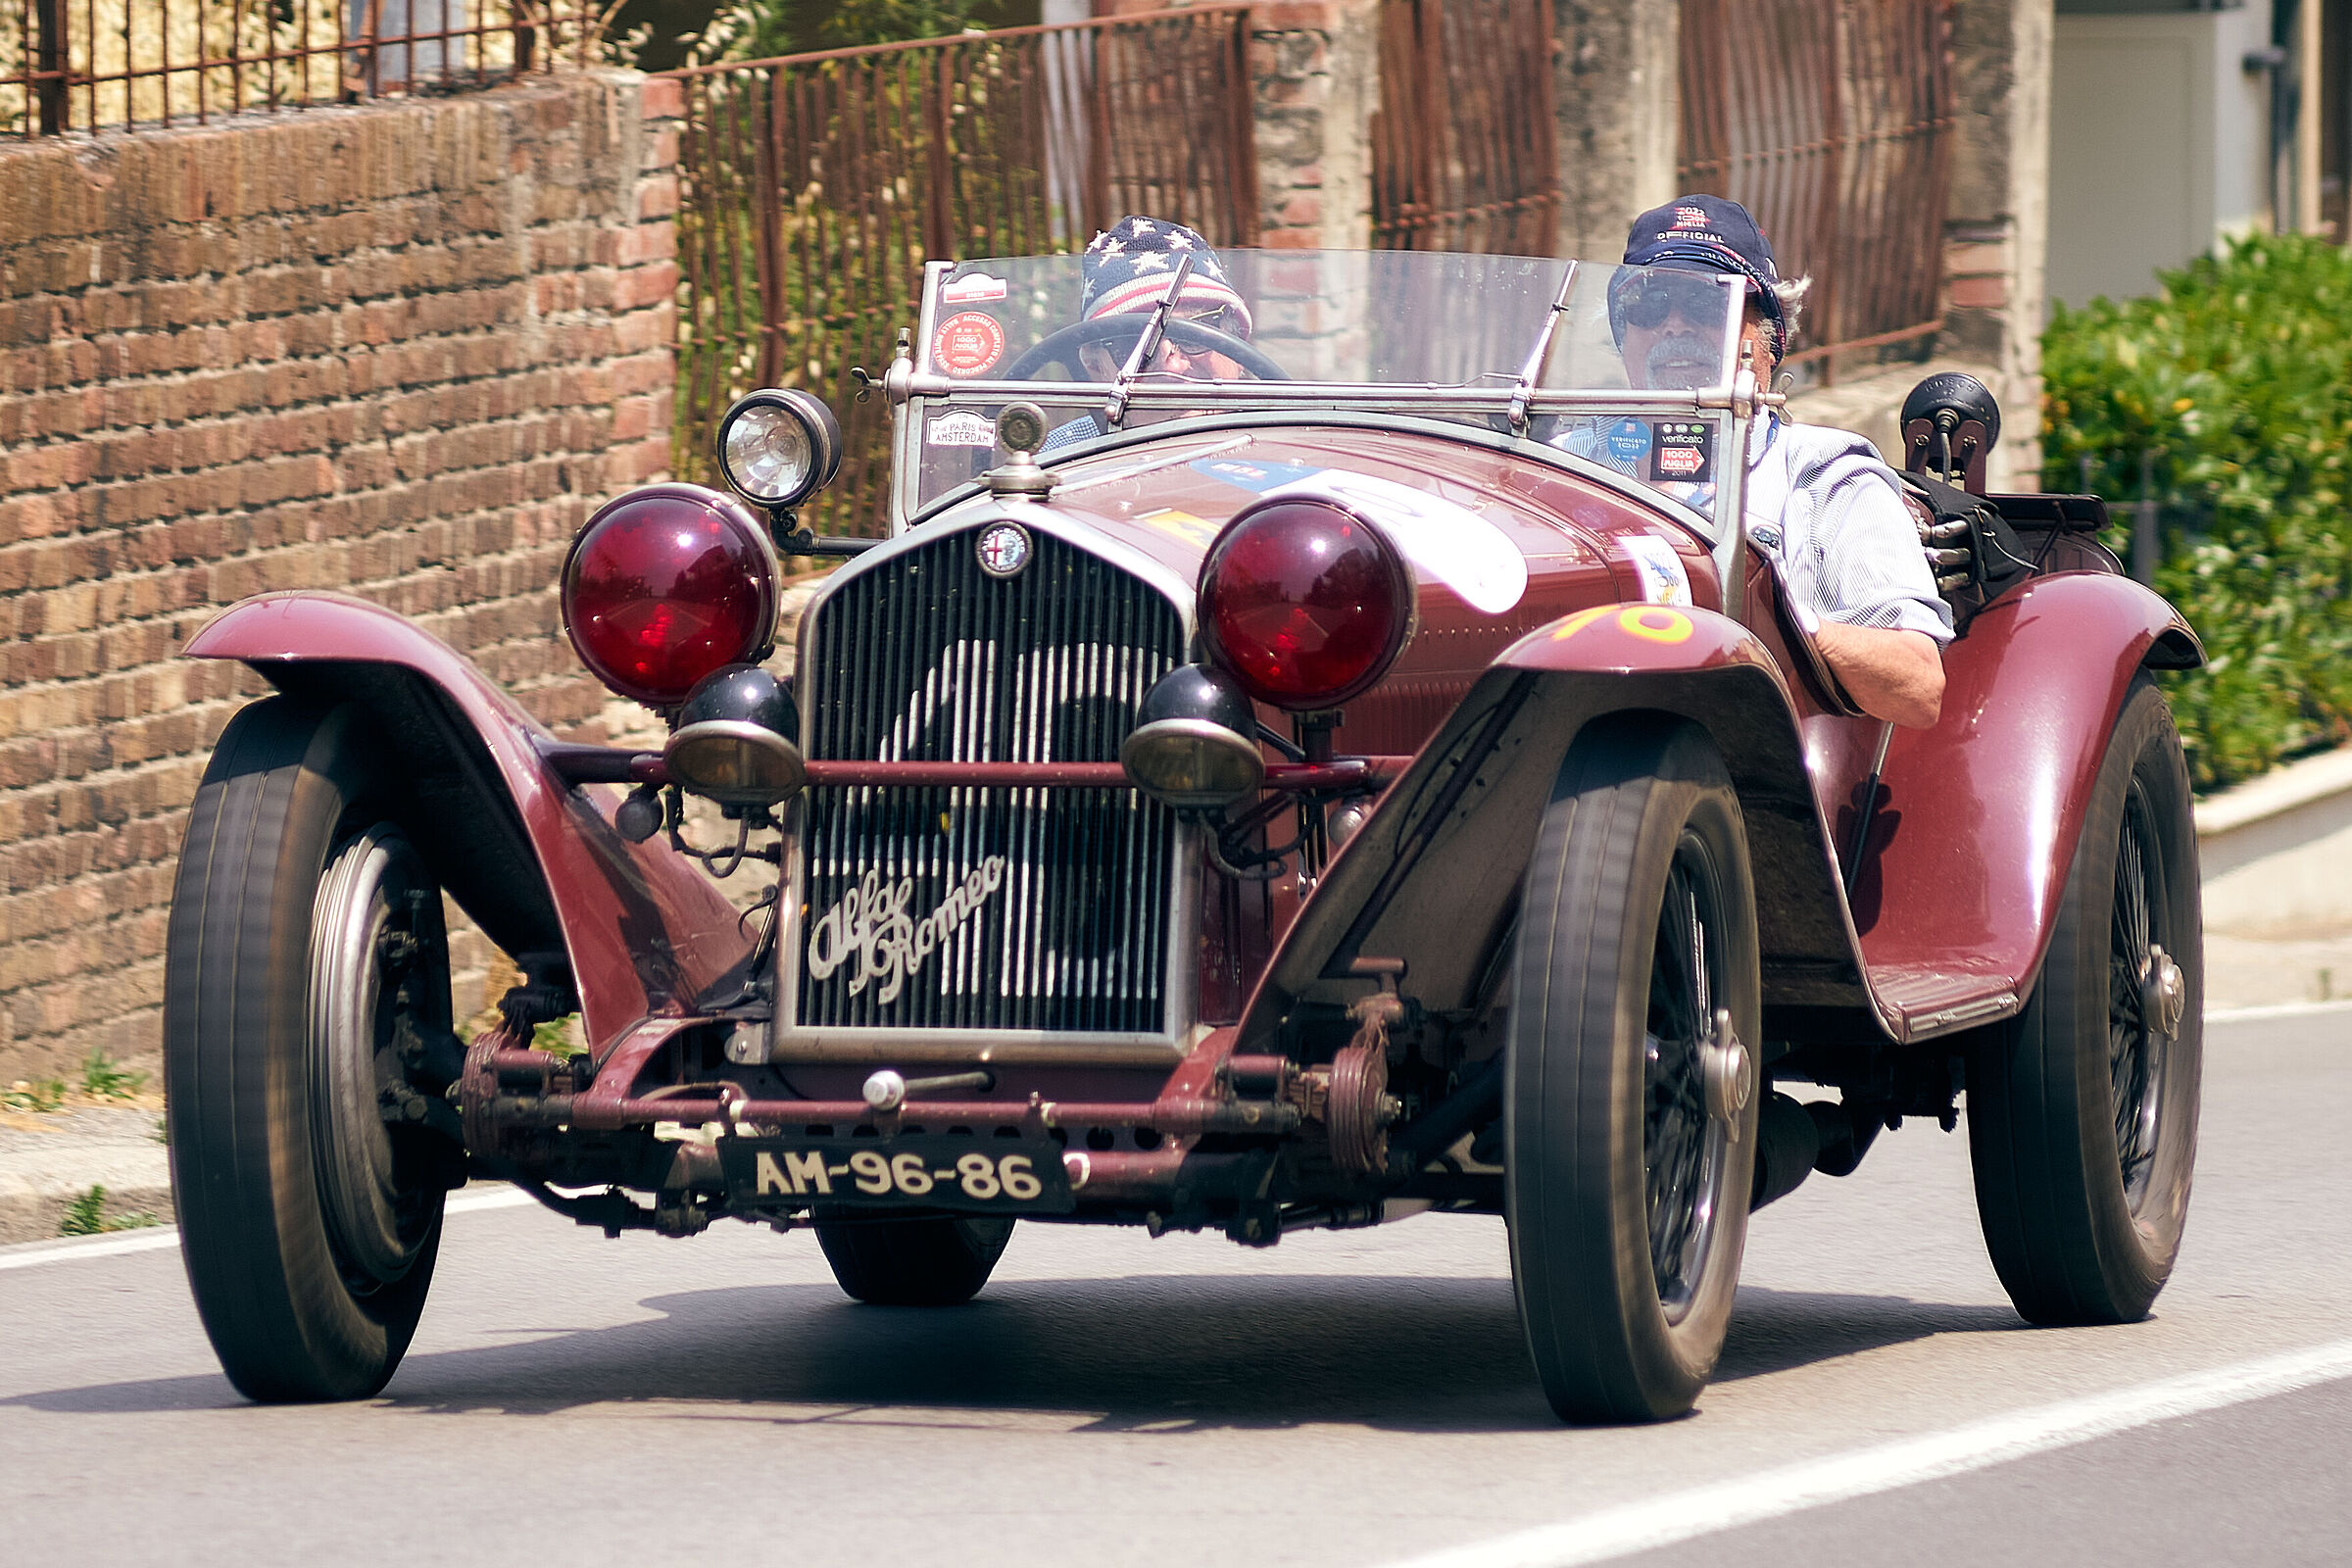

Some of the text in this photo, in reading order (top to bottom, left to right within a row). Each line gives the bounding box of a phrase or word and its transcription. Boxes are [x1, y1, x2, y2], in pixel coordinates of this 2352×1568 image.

[1677, 207, 1705, 217] 2022
[1656, 230, 1725, 243] OFFICIAL
[962, 315, 992, 328] ACCESSO
[989, 324, 1002, 356] COMPLETO
[984, 355, 995, 364] AL
[953, 362, 988, 374] PERCORSO
[950, 421, 976, 431] PARIS
[935, 431, 989, 443] AMSTERDAM
[1661, 434, 1704, 444] verificato
[1663, 459, 1694, 468] MIGLIA
[808, 855, 1005, 1005] Alfa Romeo
[756, 1151, 1043, 1200] AM-96-86
